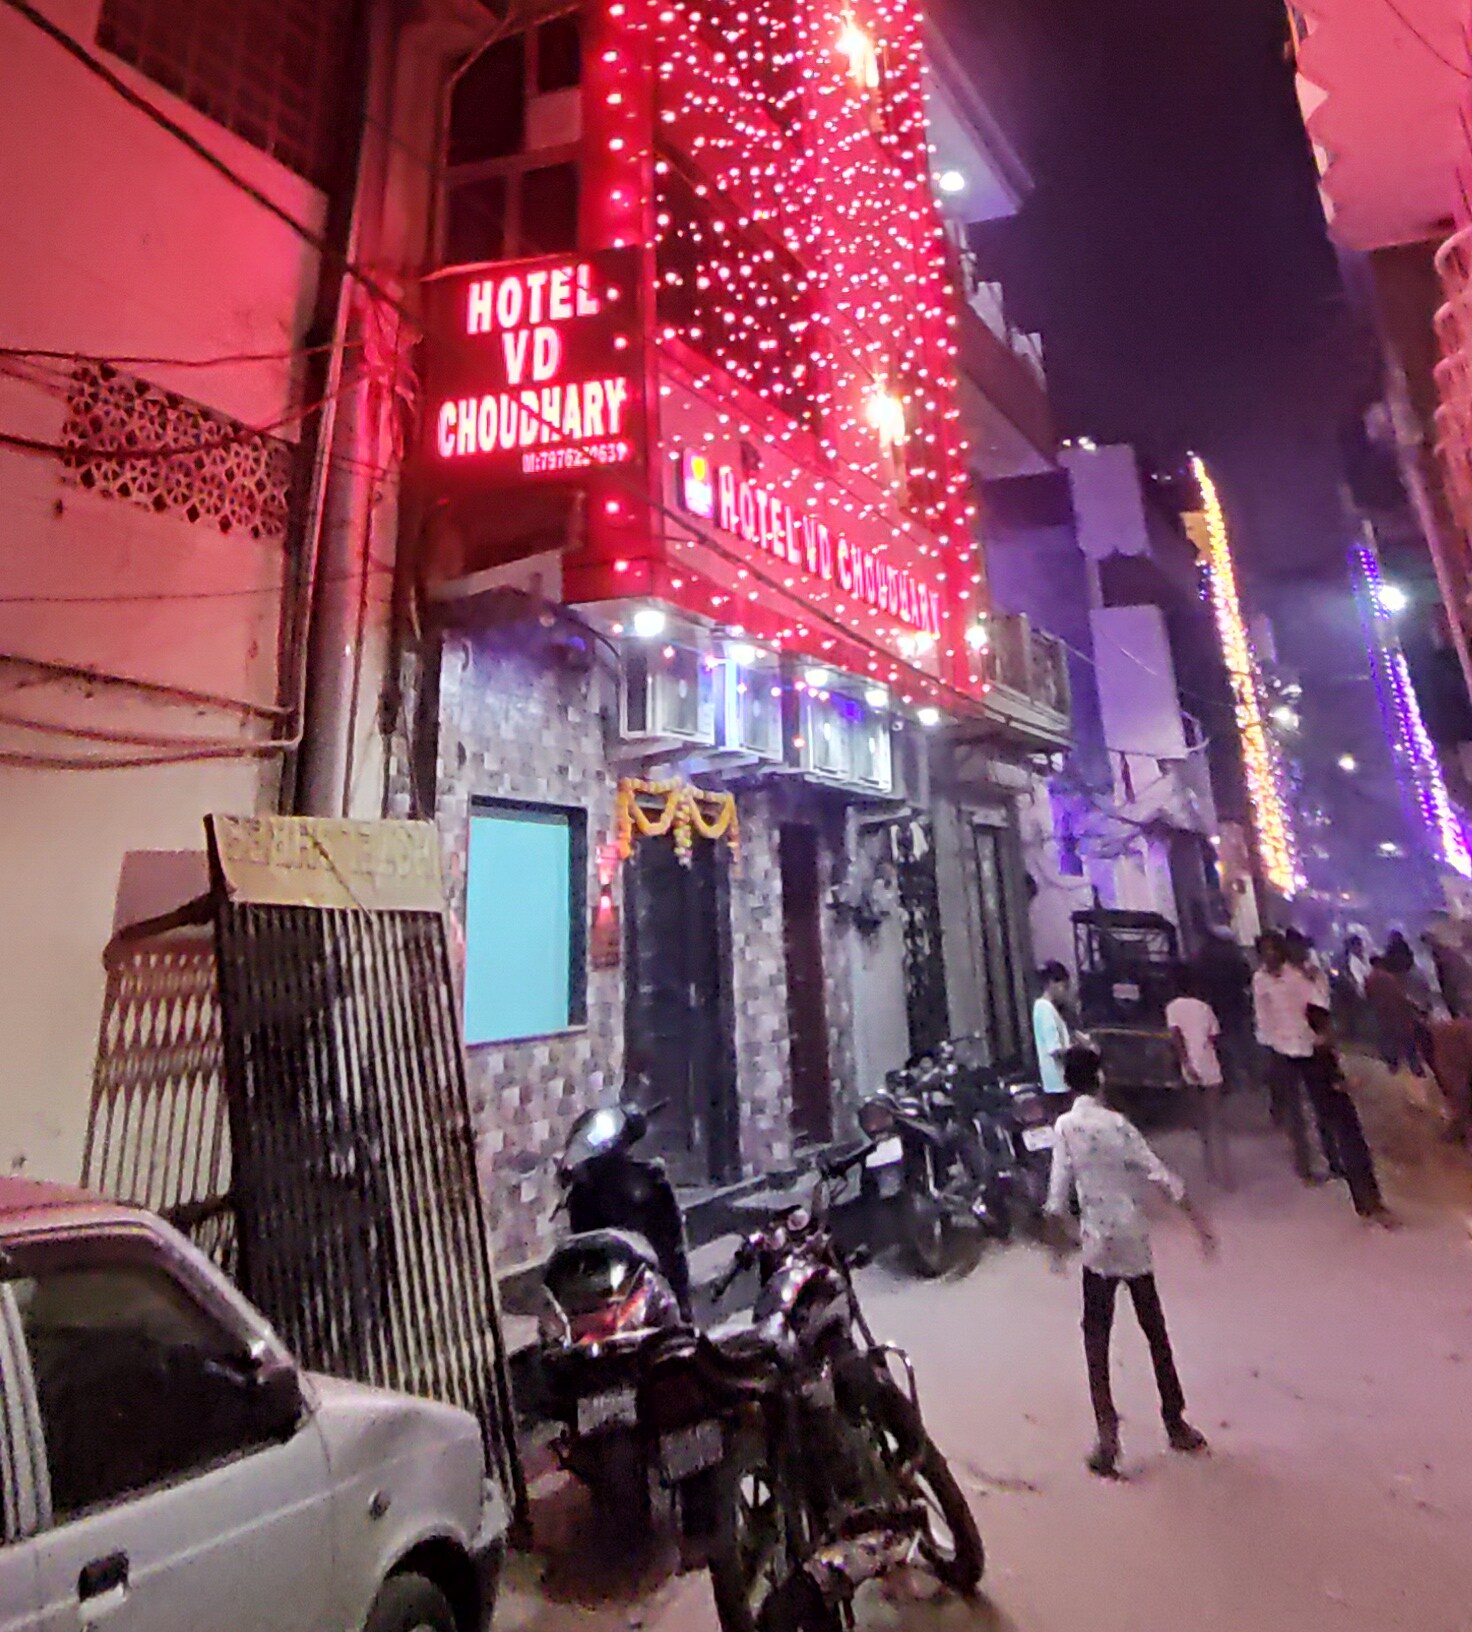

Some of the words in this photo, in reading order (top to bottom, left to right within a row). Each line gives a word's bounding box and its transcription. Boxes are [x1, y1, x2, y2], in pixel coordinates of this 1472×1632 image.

[466, 263, 599, 335] HOTEL
[502, 326, 560, 385] VD
[437, 376, 628, 457] CHOUDHARY
[719, 465, 800, 564] HOTEL
[802, 514, 832, 580] VD
[837, 537, 941, 640] CHOUDHARY
